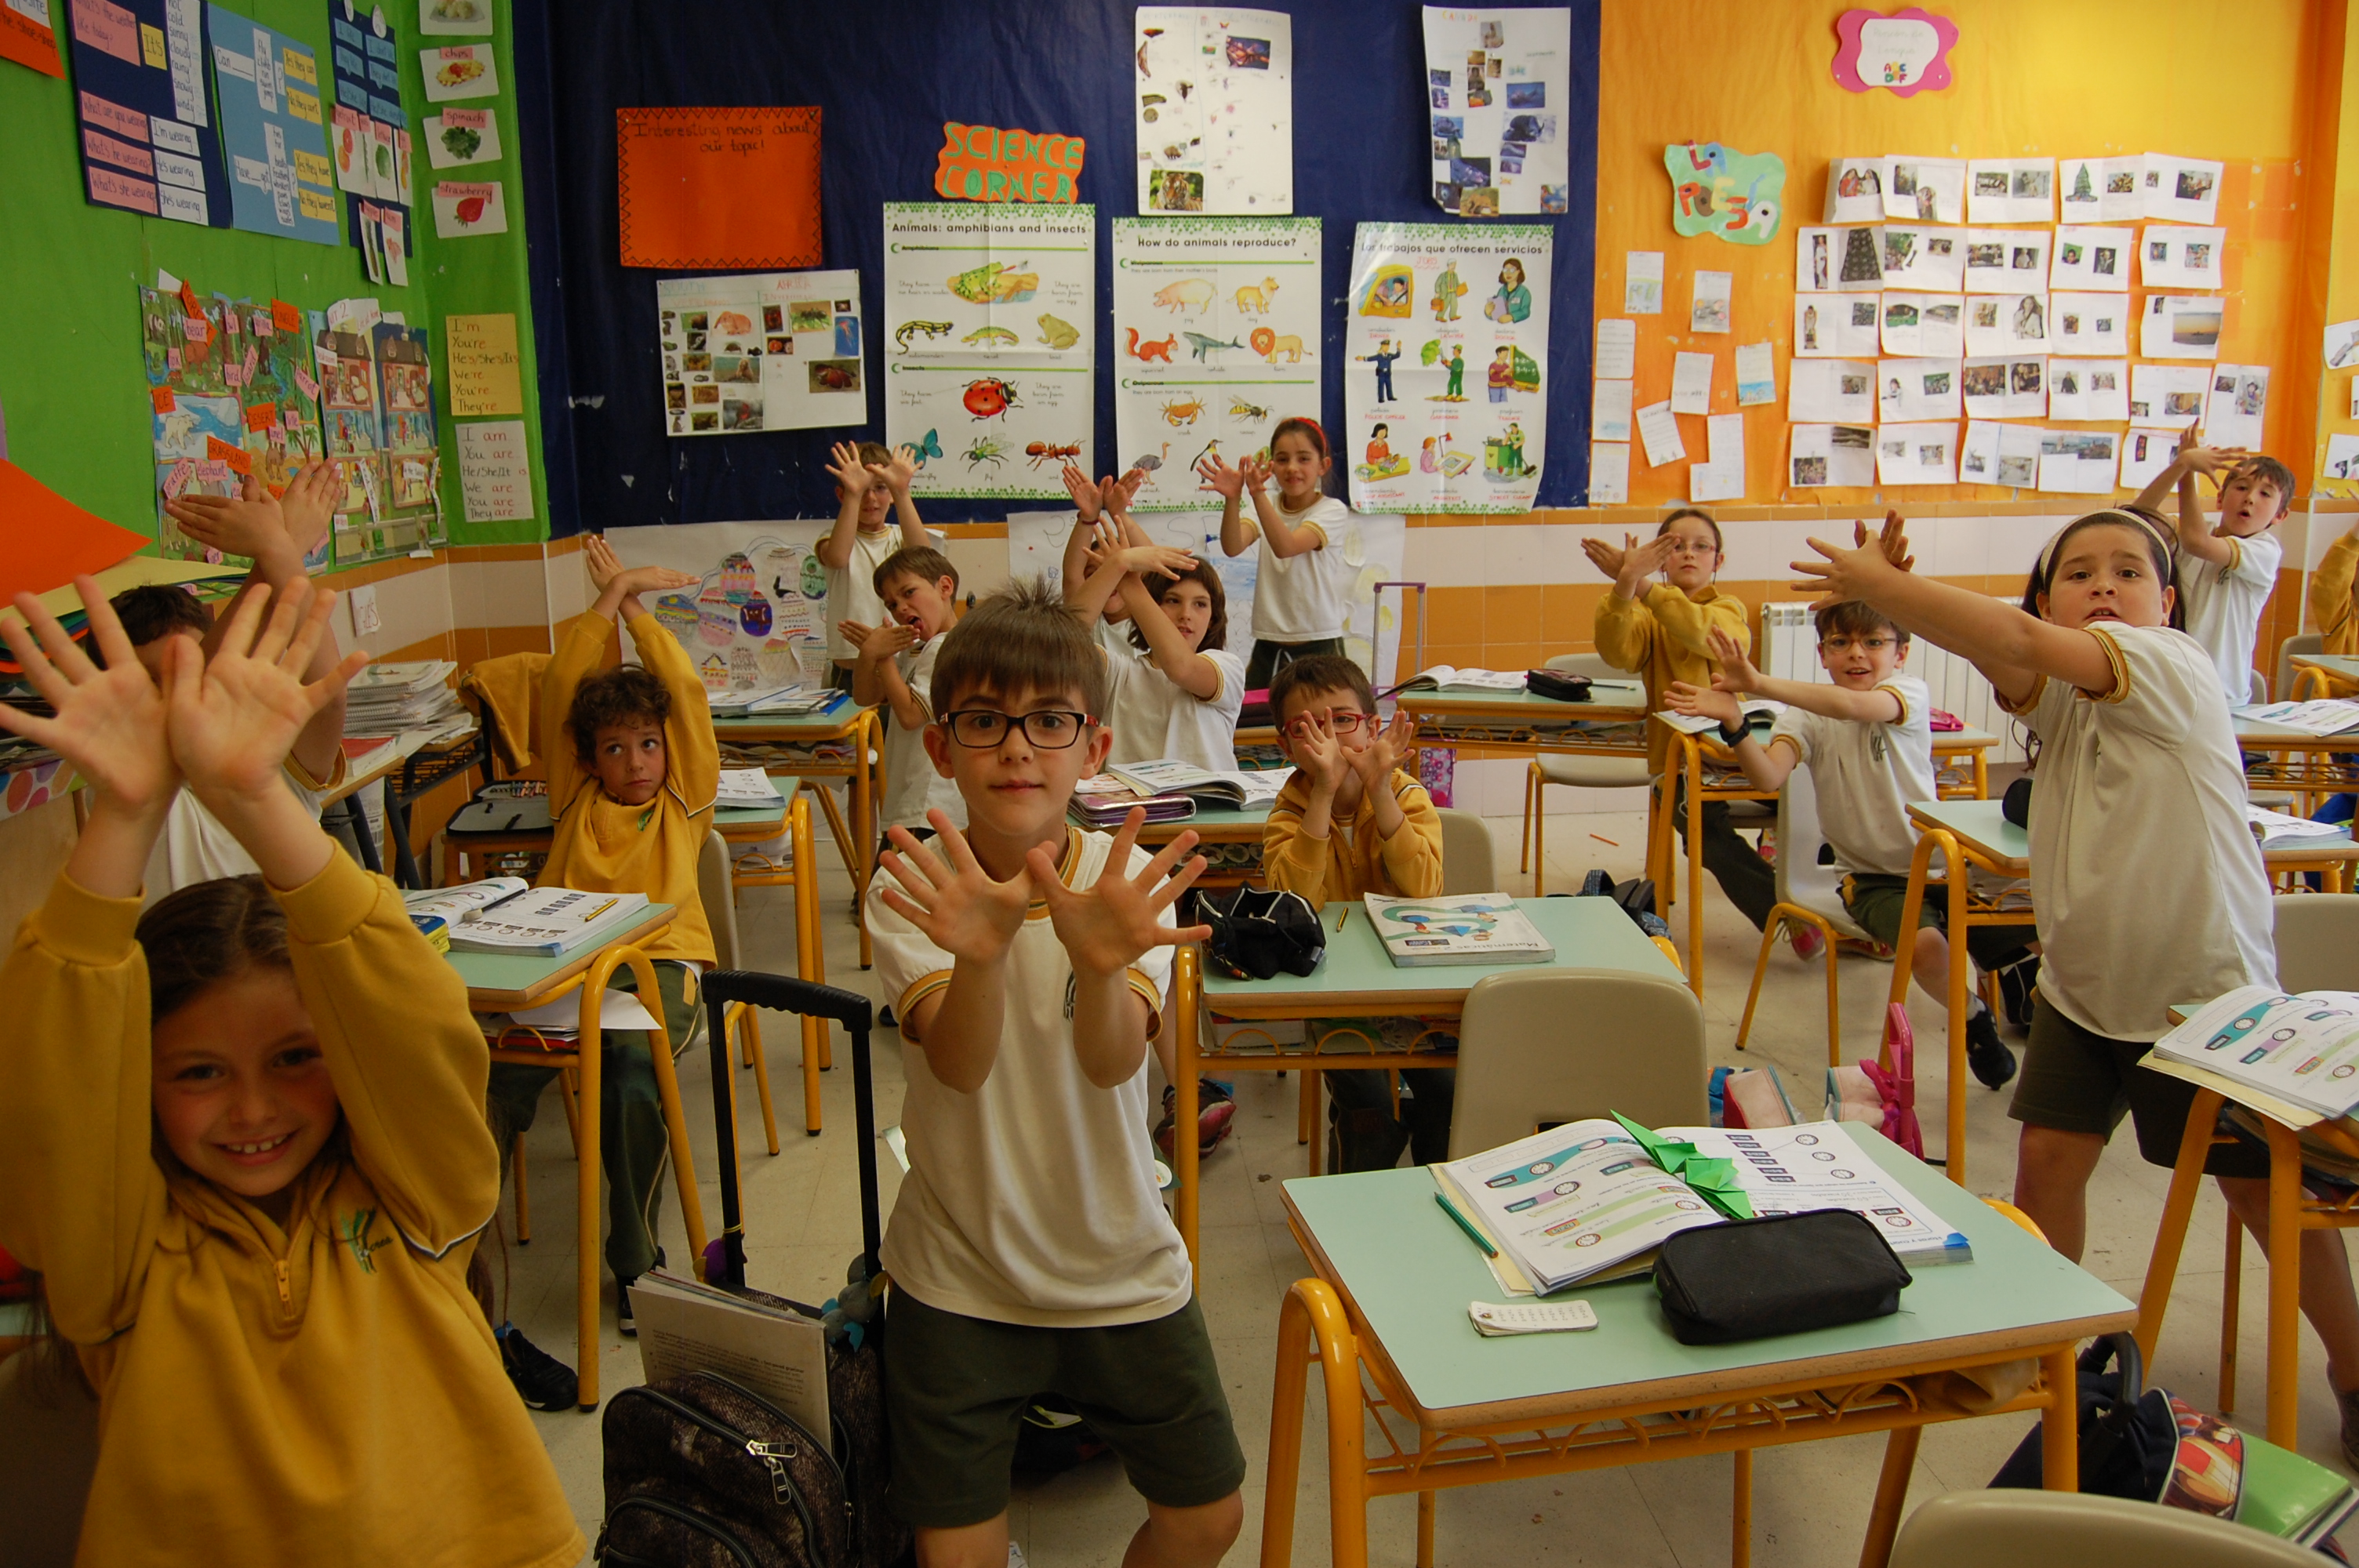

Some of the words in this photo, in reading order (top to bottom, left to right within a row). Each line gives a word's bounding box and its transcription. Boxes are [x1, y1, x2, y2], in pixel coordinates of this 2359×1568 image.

[169, 12, 184, 27] cold
[144, 33, 163, 57] It's
[169, 27, 189, 51] sunny
[170, 43, 191, 67] cloudy
[216, 49, 231, 69] Can
[445, 47, 468, 59] chips
[172, 59, 190, 83] rainy
[295, 55, 306, 81] they
[1884, 61, 1907, 73] ABC
[1885, 71, 1908, 84] DEF
[174, 78, 194, 102] snowy
[84, 96, 100, 114] What
[115, 111, 125, 132] you
[176, 96, 195, 122] windy
[447, 111, 484, 125] spinach
[151, 118, 168, 138] I'm
[632, 122, 720, 140] Interesting
[727, 125, 762, 136] news
[772, 121, 811, 134] about
[87, 136, 110, 158] What's
[112, 141, 121, 160] he
[700, 143, 723, 153] our
[730, 139, 765, 157] topic!
[943, 122, 1082, 169] SCIENCE
[156, 157, 169, 173] He's
[1688, 140, 1728, 178] LA
[306, 158, 318, 185] they
[318, 162, 330, 176] have
[92, 172, 117, 194] What's
[119, 181, 130, 197] she
[439, 183, 493, 201] strawberry
[943, 165, 1072, 204] CORNER
[160, 188, 174, 208] She's
[306, 194, 318, 216] they
[1678, 174, 1779, 239] POESÍA
[892, 223, 942, 233] Animals:
[947, 223, 1015, 234] amphibians
[1019, 223, 1041, 234] and
[1045, 223, 1087, 234] insects
[1138, 238, 1161, 248] How
[1165, 238, 1180, 248] do
[1183, 238, 1228, 248] animals
[1232, 238, 1297, 249] reproduce?
[1379, 244, 1422, 255] trabajos
[1425, 245, 1446, 255] que
[1454, 245, 1491, 254] ofrecen
[1494, 245, 1543, 255] servicios
[899, 280, 914, 289] They
[1054, 281, 1070, 290] They
[340, 303, 348, 318] 2
[187, 320, 205, 337] bear
[452, 318, 481, 332] I'm
[453, 336, 485, 350] You're
[453, 368, 484, 380] We're
[455, 383, 489, 397] You're
[900, 390, 916, 399] They
[1034, 382, 1051, 391] They
[458, 398, 497, 415] They're
[462, 426, 474, 442] I
[483, 431, 507, 442] am
[208, 438, 249, 469] GRASSLAND
[464, 445, 485, 460] You
[493, 448, 514, 459] are
[197, 462, 226, 479] elephant
[461, 464, 511, 477] He/She/It
[518, 467, 527, 476] is
[984, 473, 994, 481] fly
[463, 481, 482, 493] We
[492, 483, 513, 493] are
[467, 496, 488, 507] You
[493, 497, 514, 507] are
[469, 508, 493, 521] They
[495, 507, 514, 517] are
[1456, 942, 1539, 950] Matemáticas
